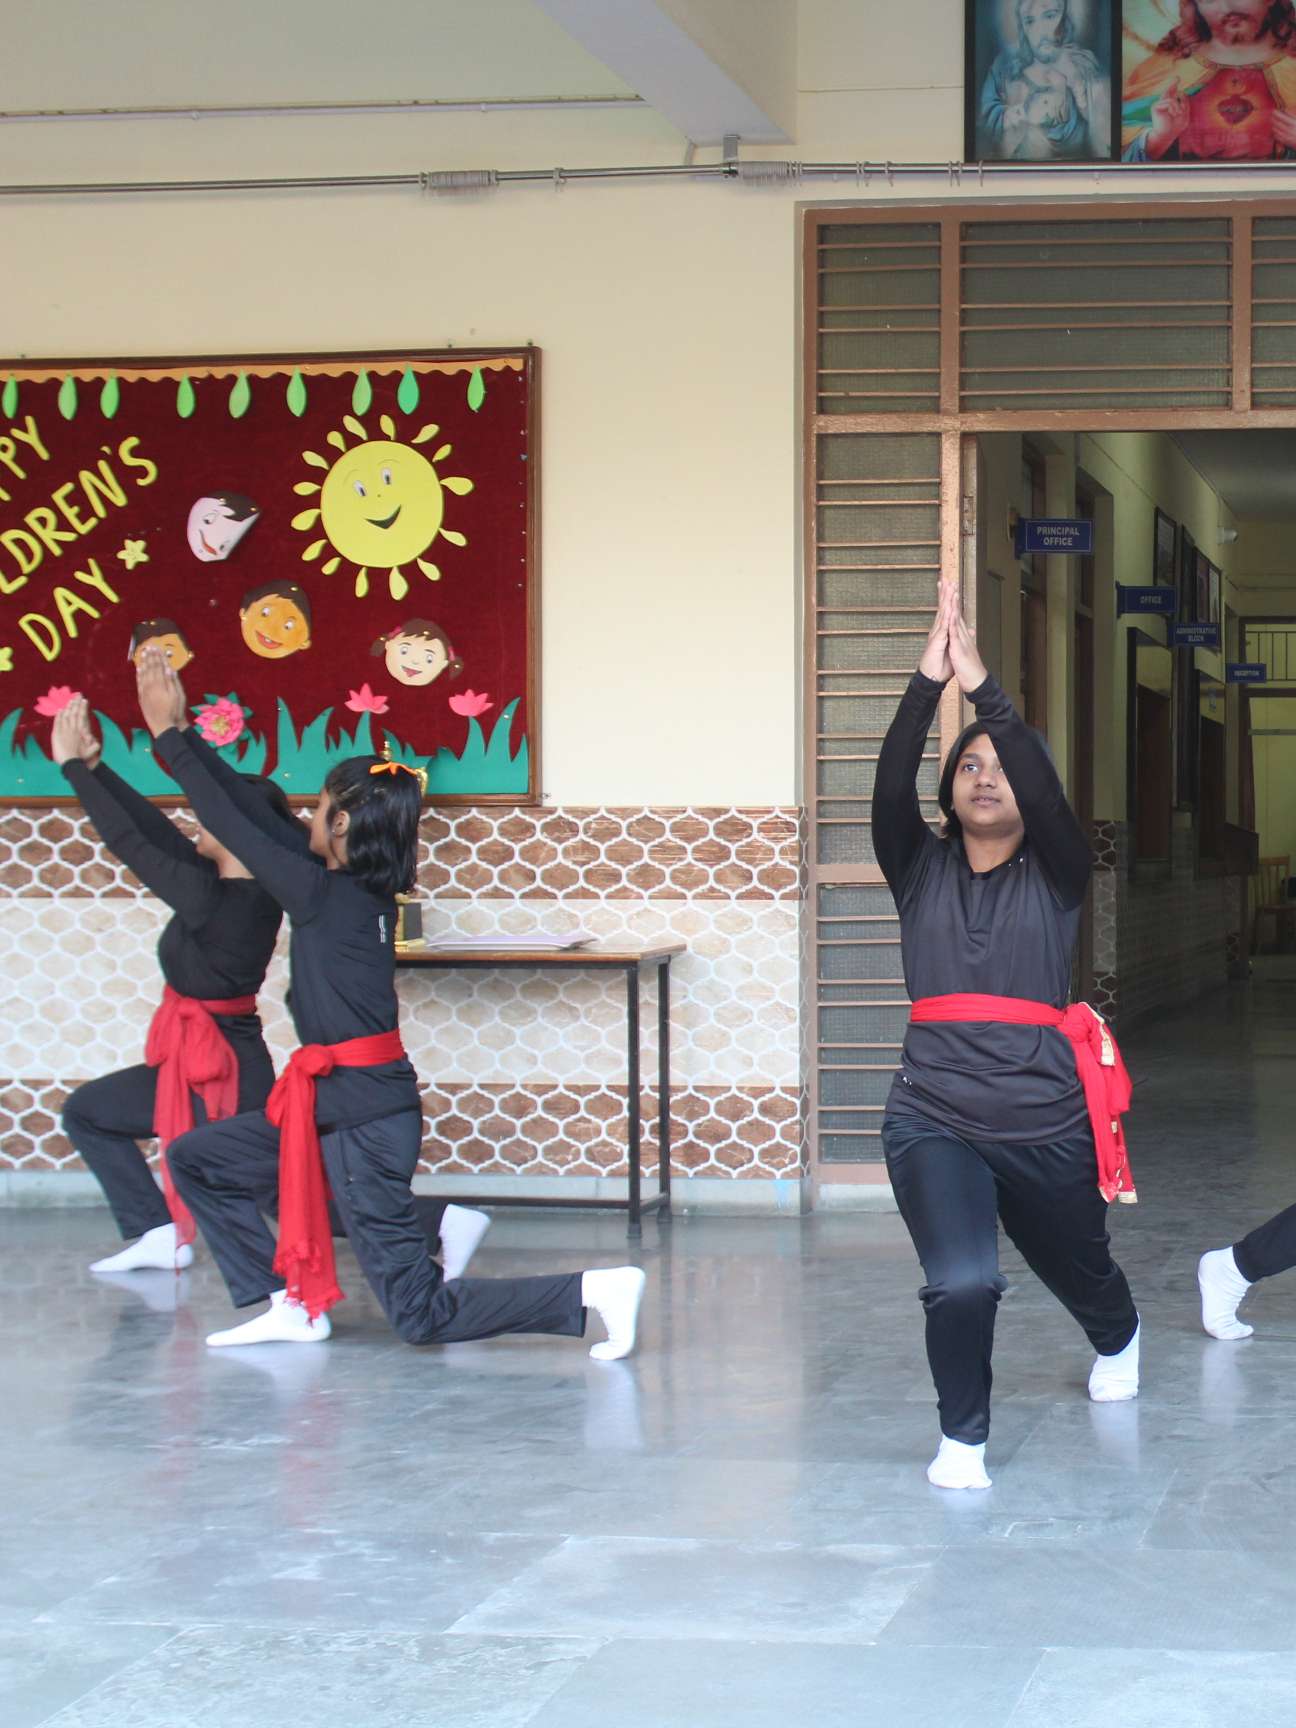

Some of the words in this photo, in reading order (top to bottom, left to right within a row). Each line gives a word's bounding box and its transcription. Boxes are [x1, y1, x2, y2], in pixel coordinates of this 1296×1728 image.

[1036, 526, 1080, 536] PRINCIPAL
[1043, 537, 1073, 546] OFFICE
[1139, 595, 1162, 604] OFFICE
[18, 558, 120, 662] DAY
